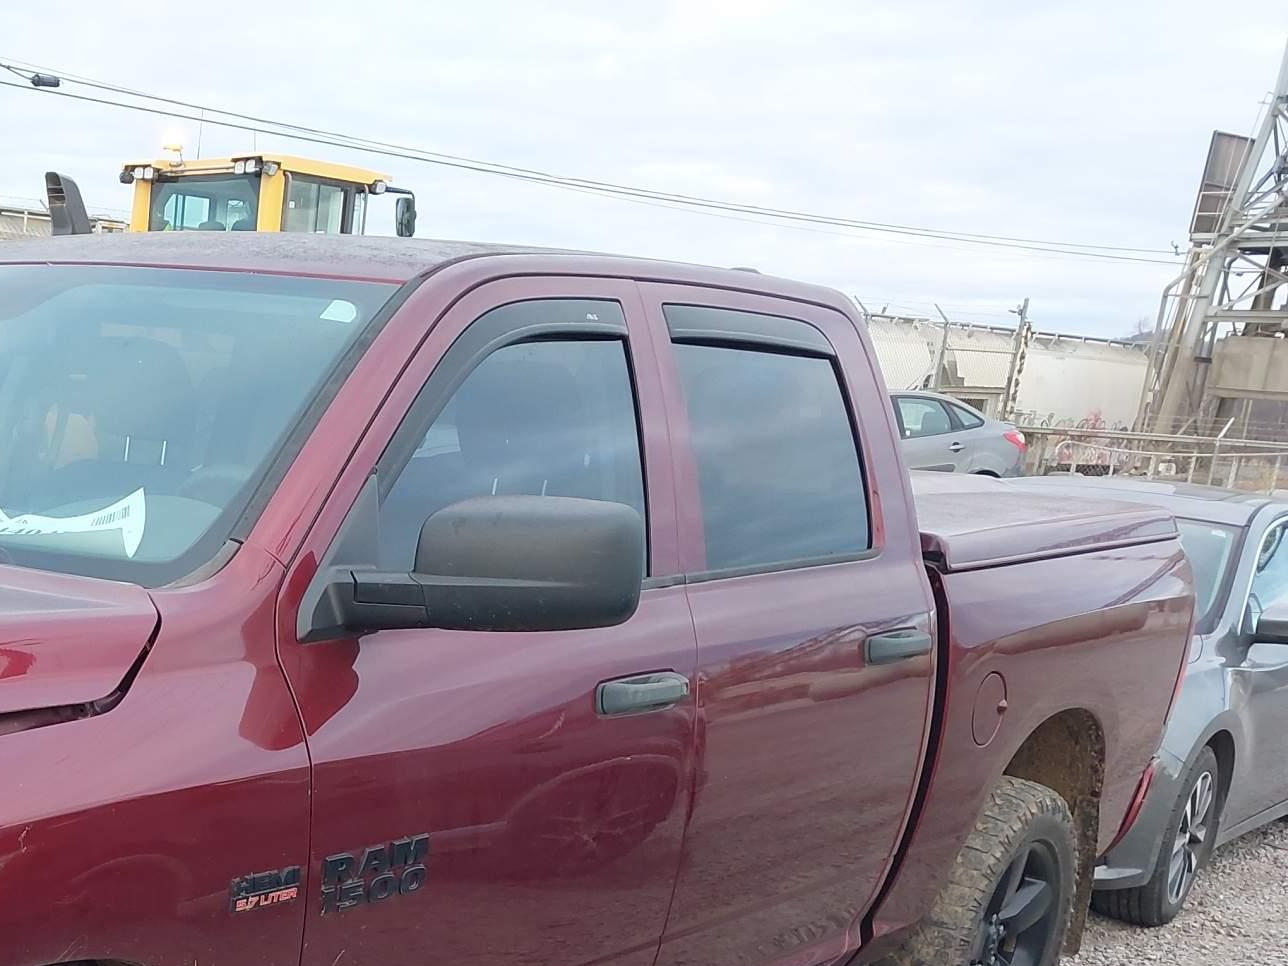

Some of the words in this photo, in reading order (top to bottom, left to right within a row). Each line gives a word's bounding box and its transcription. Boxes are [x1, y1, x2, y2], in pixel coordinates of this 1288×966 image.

[321, 832, 430, 883] RAM
[231, 865, 301, 898] HEMI
[235, 896, 260, 912] 5.7
[259, 887, 299, 906] LITER
[319, 864, 426, 917] 1500
